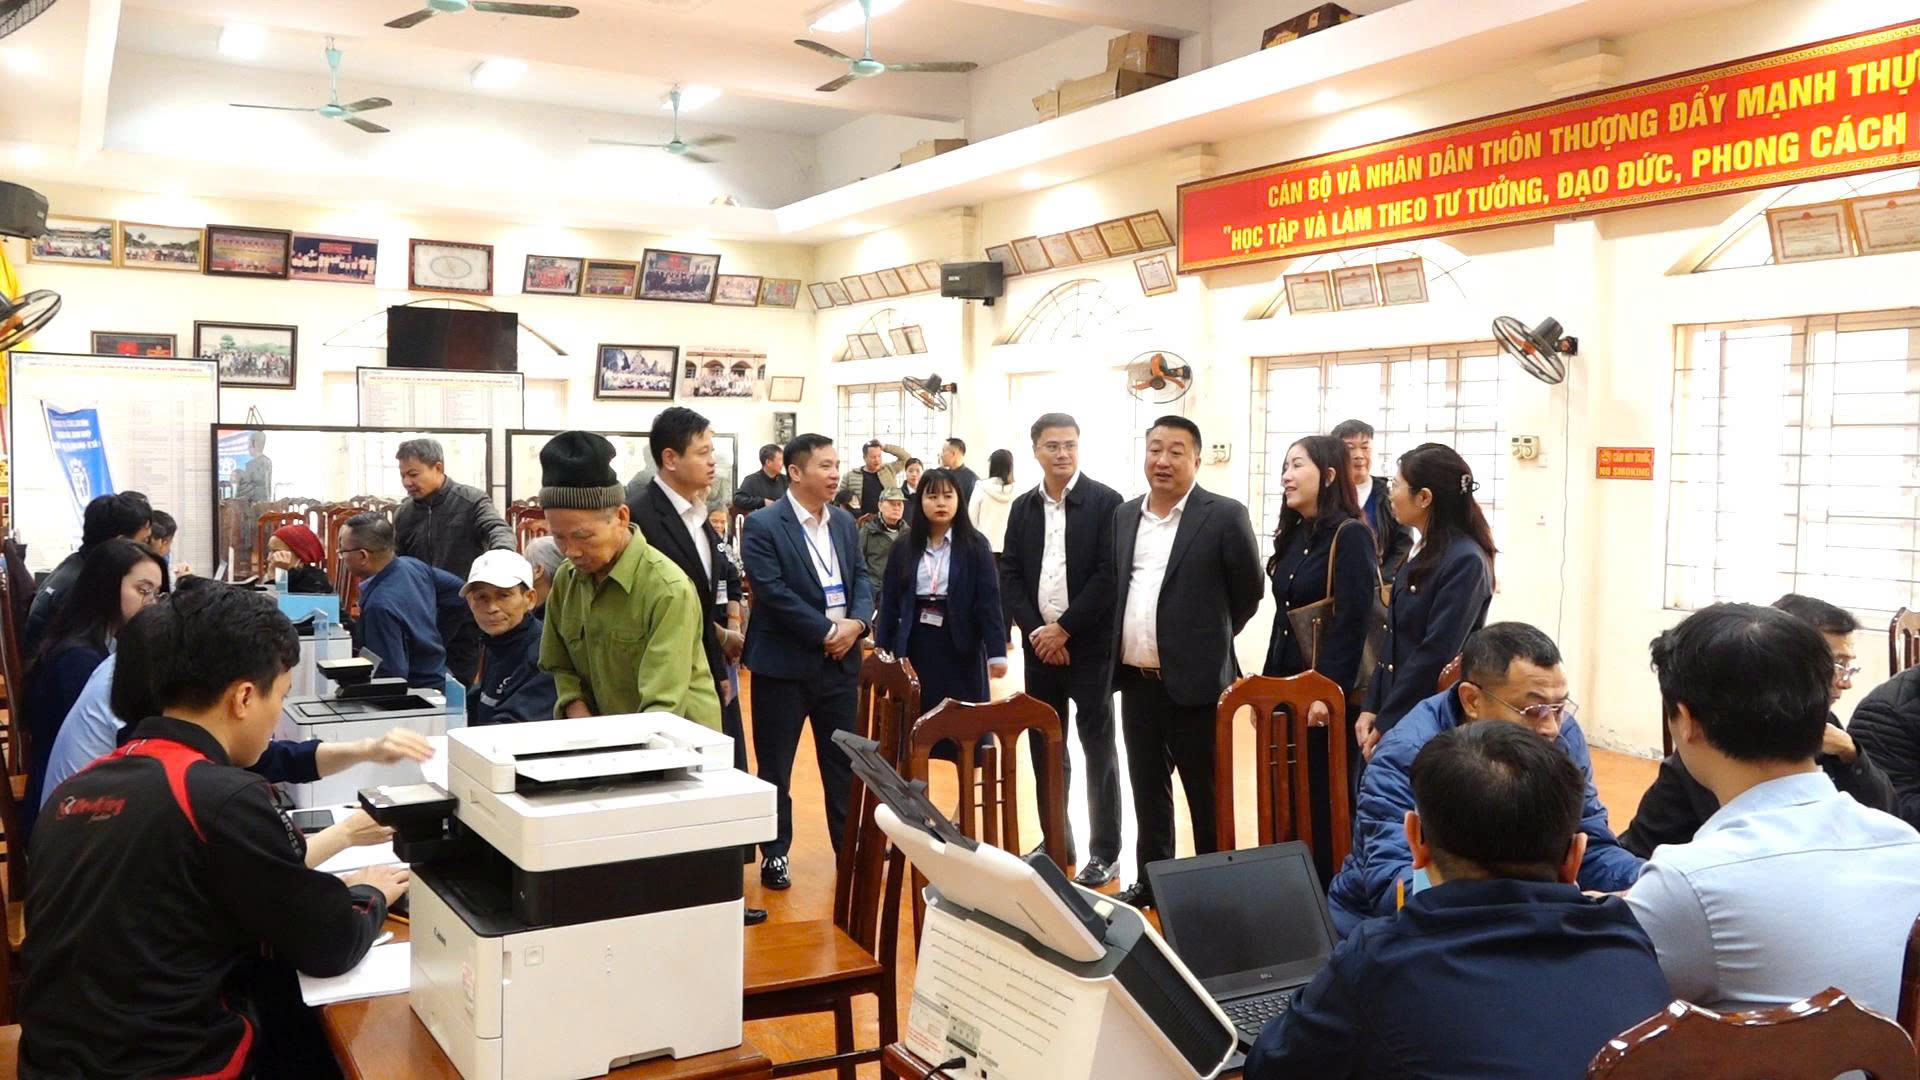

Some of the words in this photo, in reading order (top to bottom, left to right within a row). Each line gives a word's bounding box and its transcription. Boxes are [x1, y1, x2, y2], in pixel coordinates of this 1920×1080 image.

[1268, 179, 1303, 208] CÁN
[1308, 170, 1332, 203] BỘ
[1337, 164, 1361, 195] VÀ
[1367, 155, 1423, 189] NHÂN
[1428, 143, 1474, 177] DÂN
[1481, 130, 1541, 168] THÔN
[1550, 108, 1659, 152] THƯỢNG
[1668, 85, 1727, 132] ĐẨY
[1737, 70, 1836, 120] MẠNH
[1847, 48, 1920, 97] THỰ
[1268, 217, 1299, 248] TẬP
[1304, 210, 1327, 240] VÀ
[1332, 205, 1373, 236] LÀM
[1377, 196, 1427, 228] THEO
[1433, 189, 1462, 219] TƯ
[1466, 174, 1549, 214] TƯỞNG,
[1557, 165, 1609, 202] ĐẠO
[1617, 151, 1682, 190] ĐỨC,
[1692, 132, 1799, 178] PHONG
[1810, 111, 1907, 158] CÁCH
[1613, 466, 1651, 477] SMOKING
